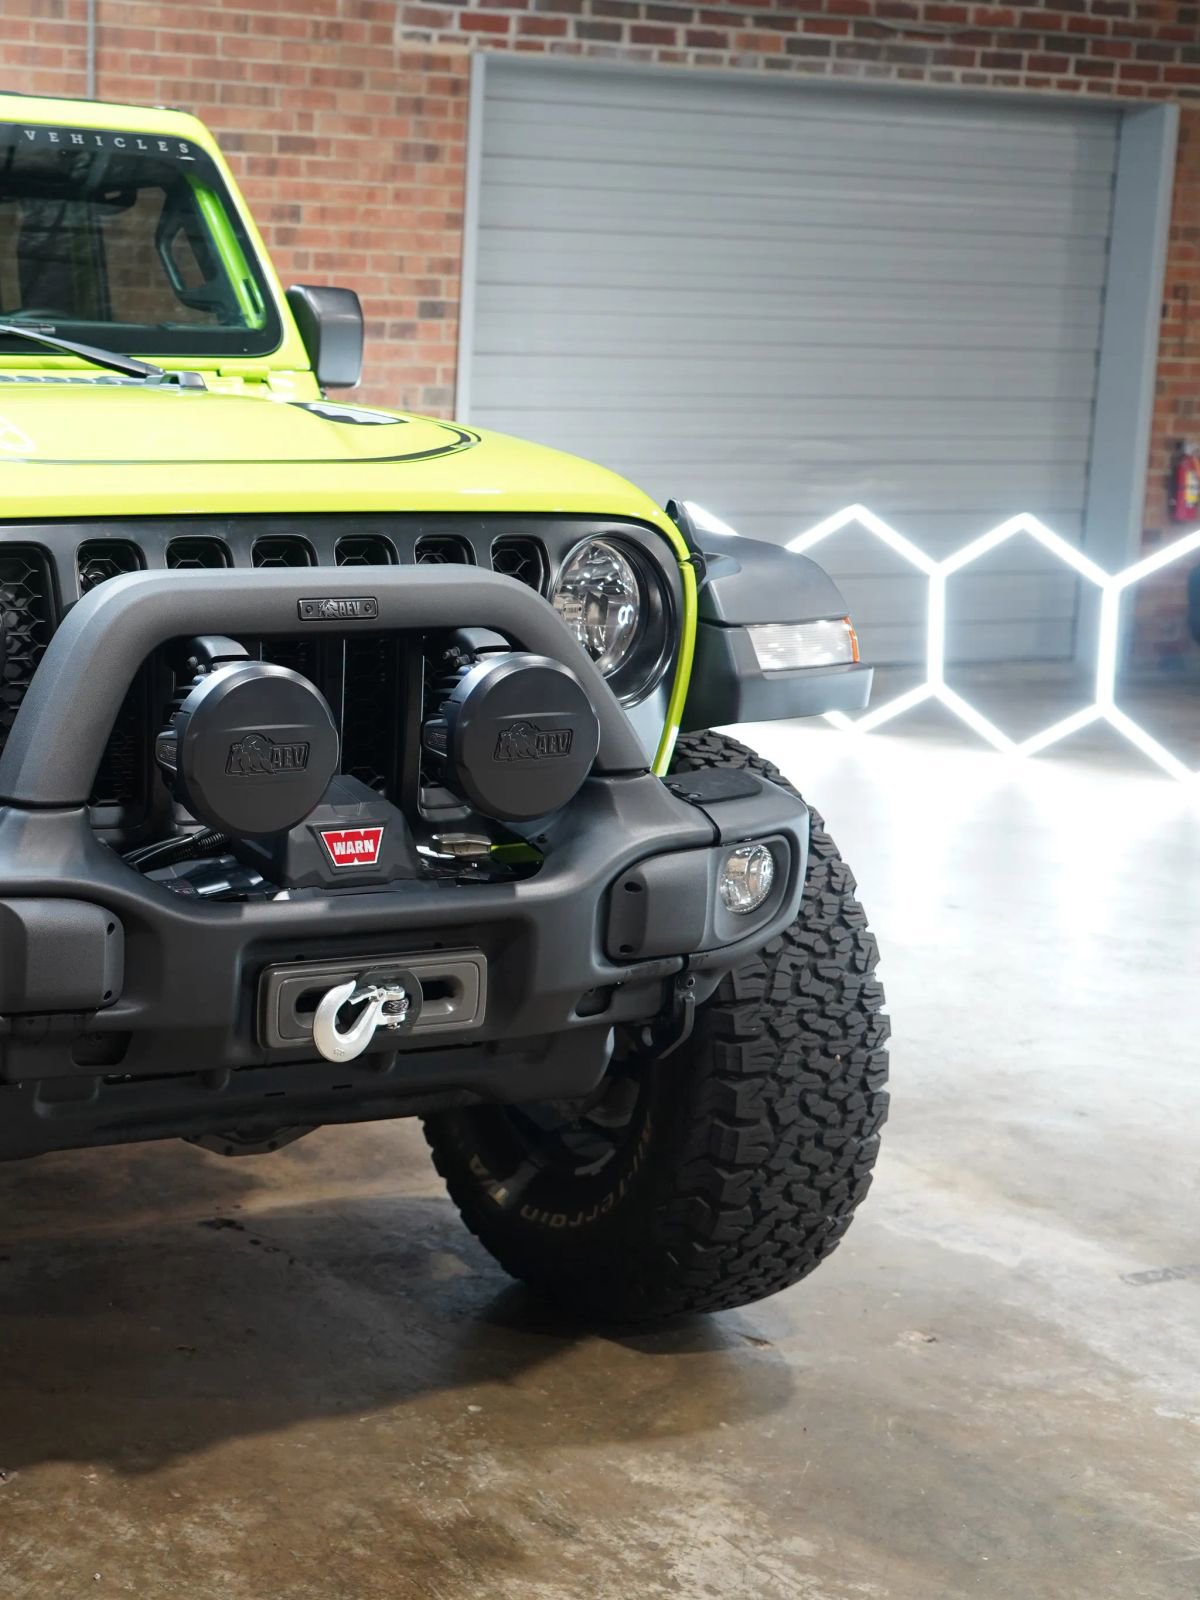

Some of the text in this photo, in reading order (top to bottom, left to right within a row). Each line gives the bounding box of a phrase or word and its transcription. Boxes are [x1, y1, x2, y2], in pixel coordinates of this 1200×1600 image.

[25, 130, 190, 154] VEHICLES
[340, 601, 360, 617] AEV
[537, 732, 569, 754] AEV
[272, 744, 307, 768] AEV
[332, 839, 375, 856] WARN
